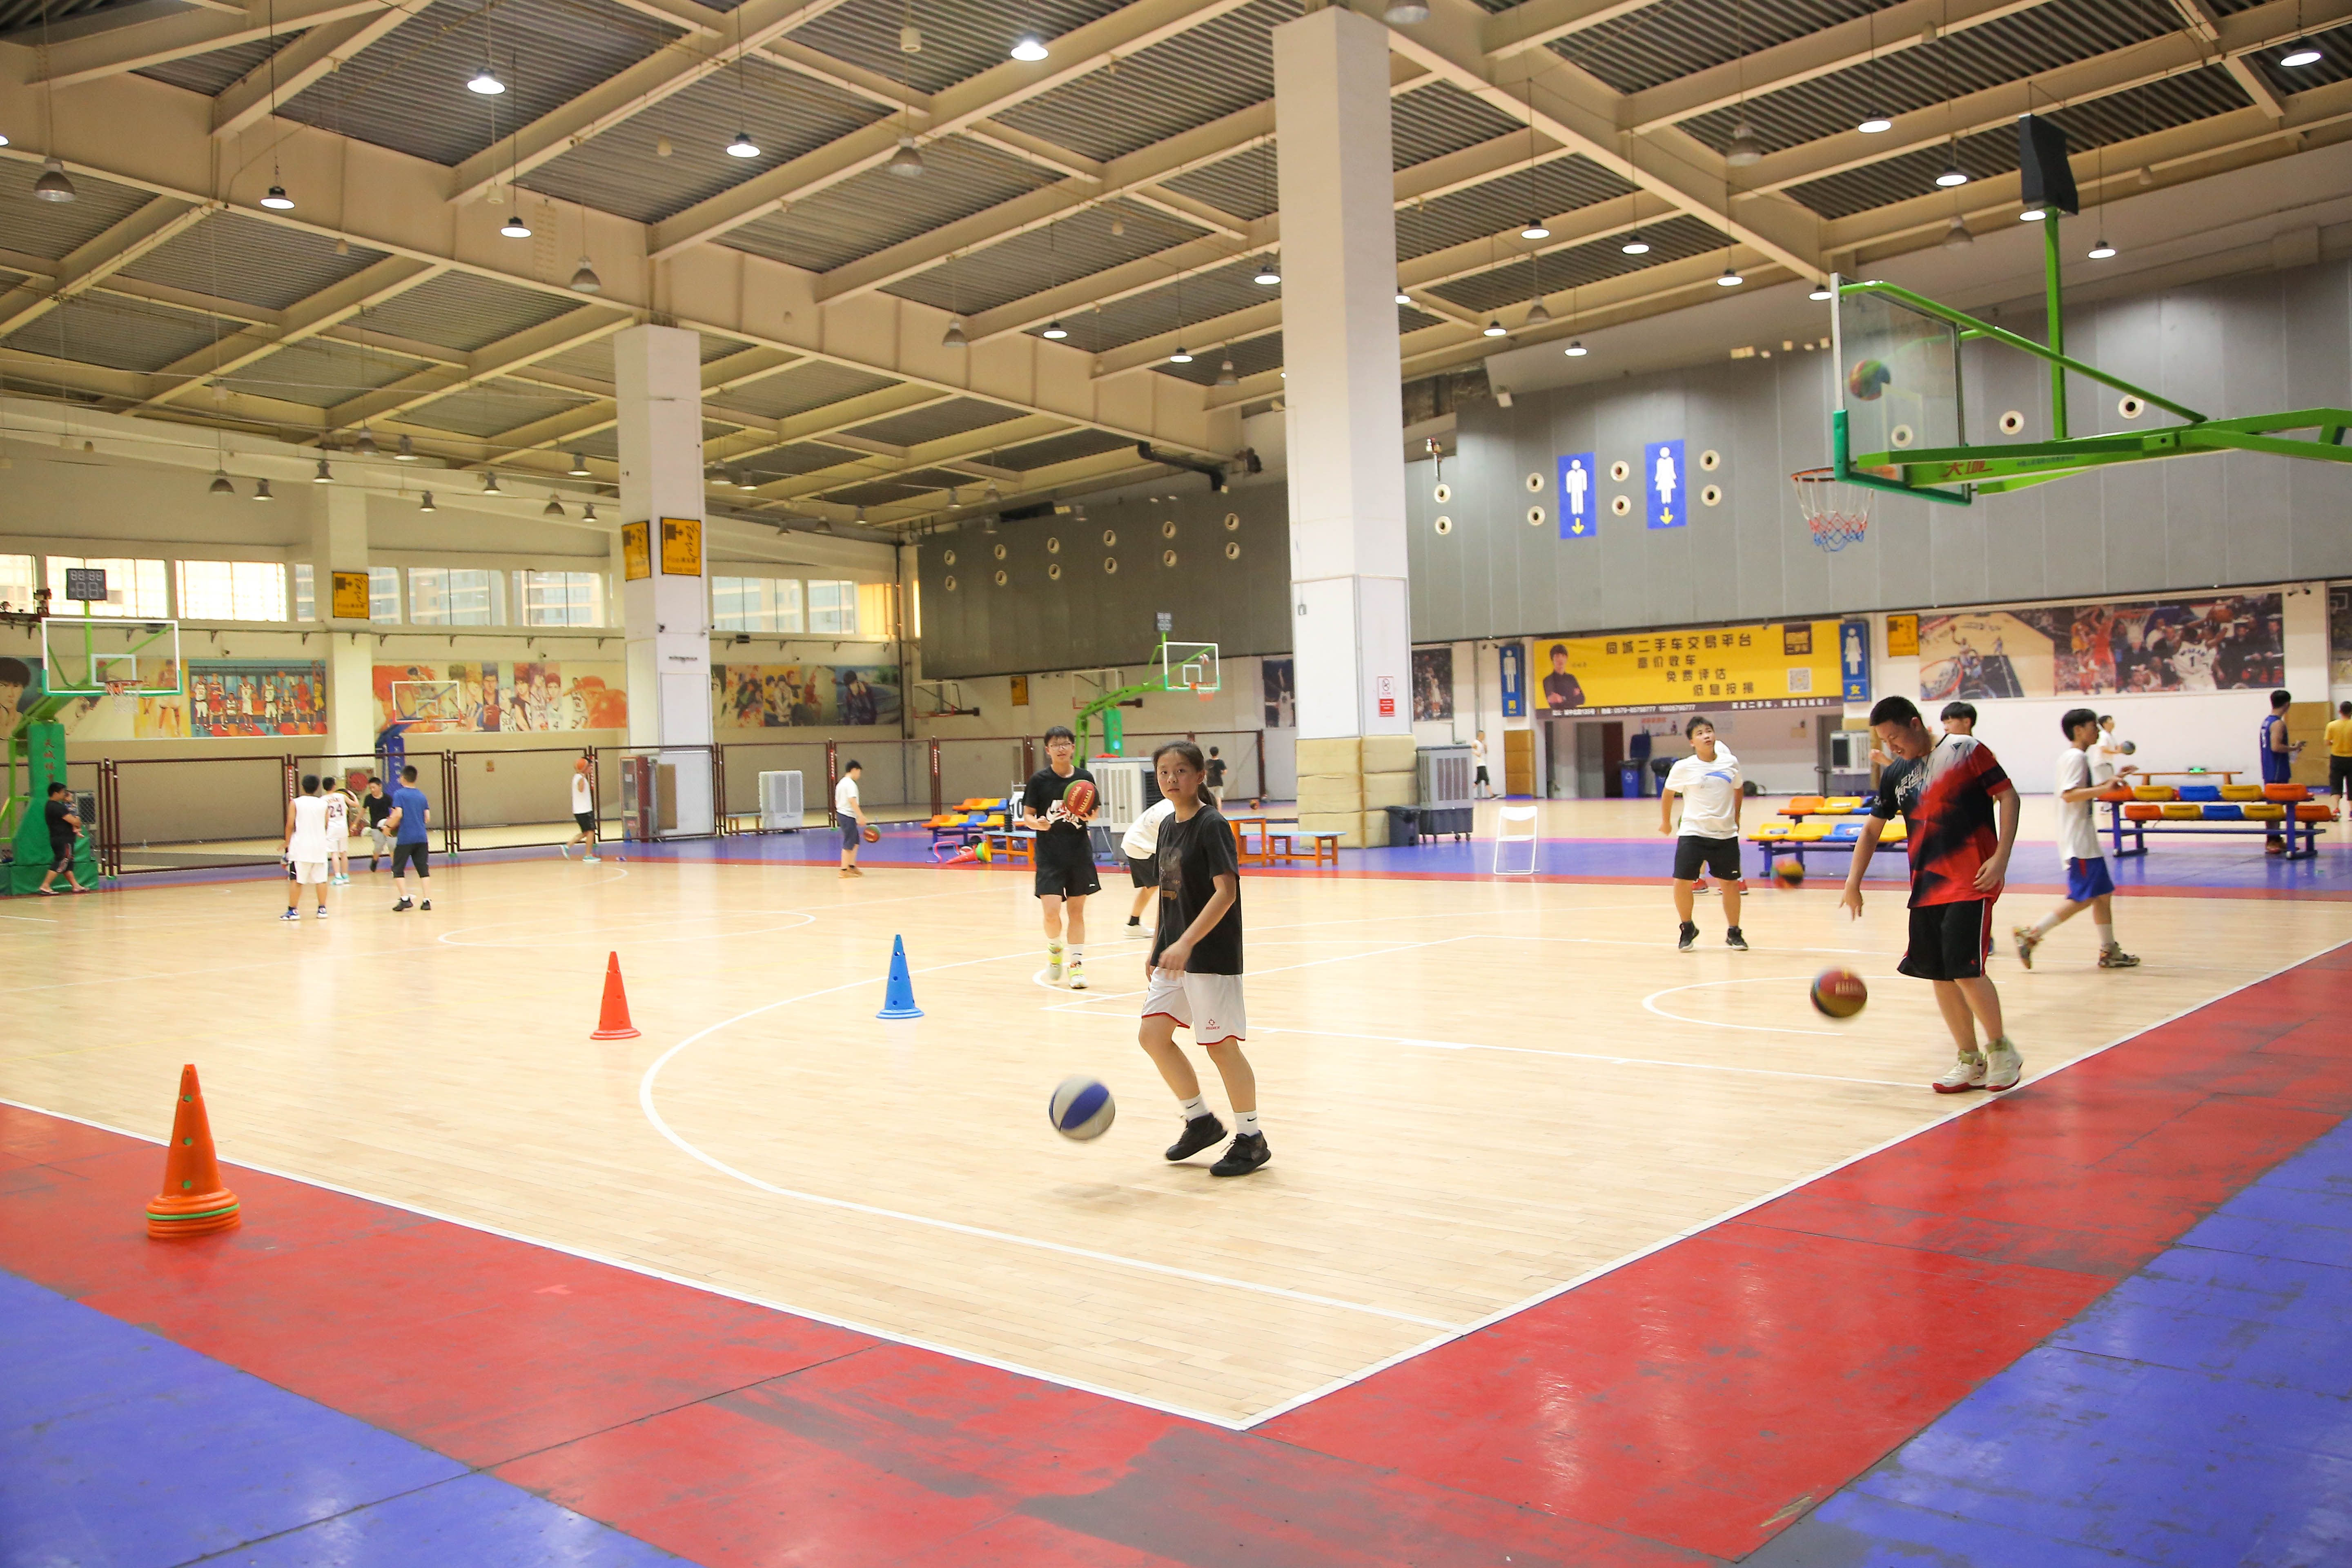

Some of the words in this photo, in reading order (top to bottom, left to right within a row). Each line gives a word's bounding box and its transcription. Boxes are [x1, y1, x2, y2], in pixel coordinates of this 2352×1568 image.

[1606, 633, 1751, 654] 同城二手车交易平台
[1638, 655, 1696, 669] 高价收车
[1667, 668, 1726, 682] 免费评估
[1850, 684, 1860, 695] 女
[327, 804, 343, 817] 24
